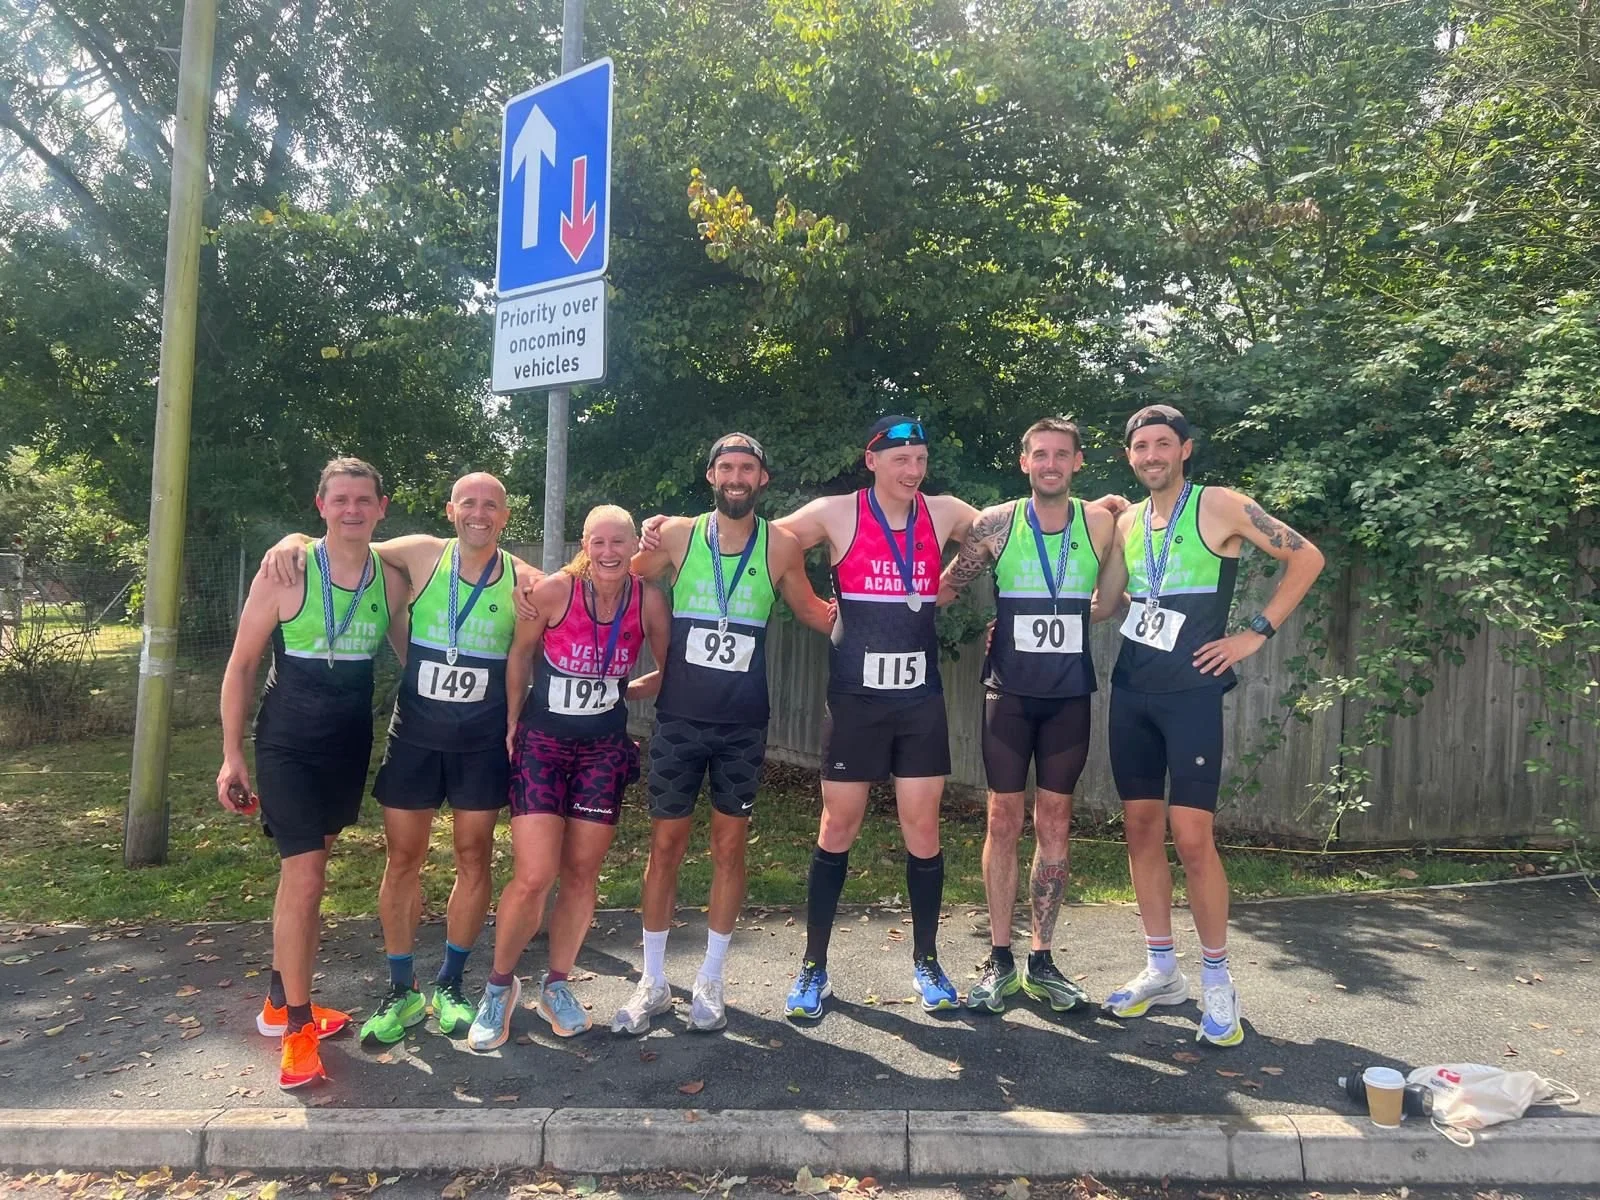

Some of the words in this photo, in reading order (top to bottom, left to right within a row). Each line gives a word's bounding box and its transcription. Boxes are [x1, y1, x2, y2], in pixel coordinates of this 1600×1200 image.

[500, 302, 557, 329] Priority
[563, 296, 599, 316] over
[509, 326, 586, 354] oncoming
[514, 355, 580, 380] vehicles
[871, 560, 926, 576] VECIS
[864, 577, 931, 592] ACADMY
[1032, 618, 1065, 649] 90
[1135, 611, 1166, 641] 89
[571, 643, 630, 663] VECIS
[704, 632, 737, 665] 93
[429, 666, 477, 700] 149
[878, 656, 917, 686] 115
[563, 679, 608, 709] 192
